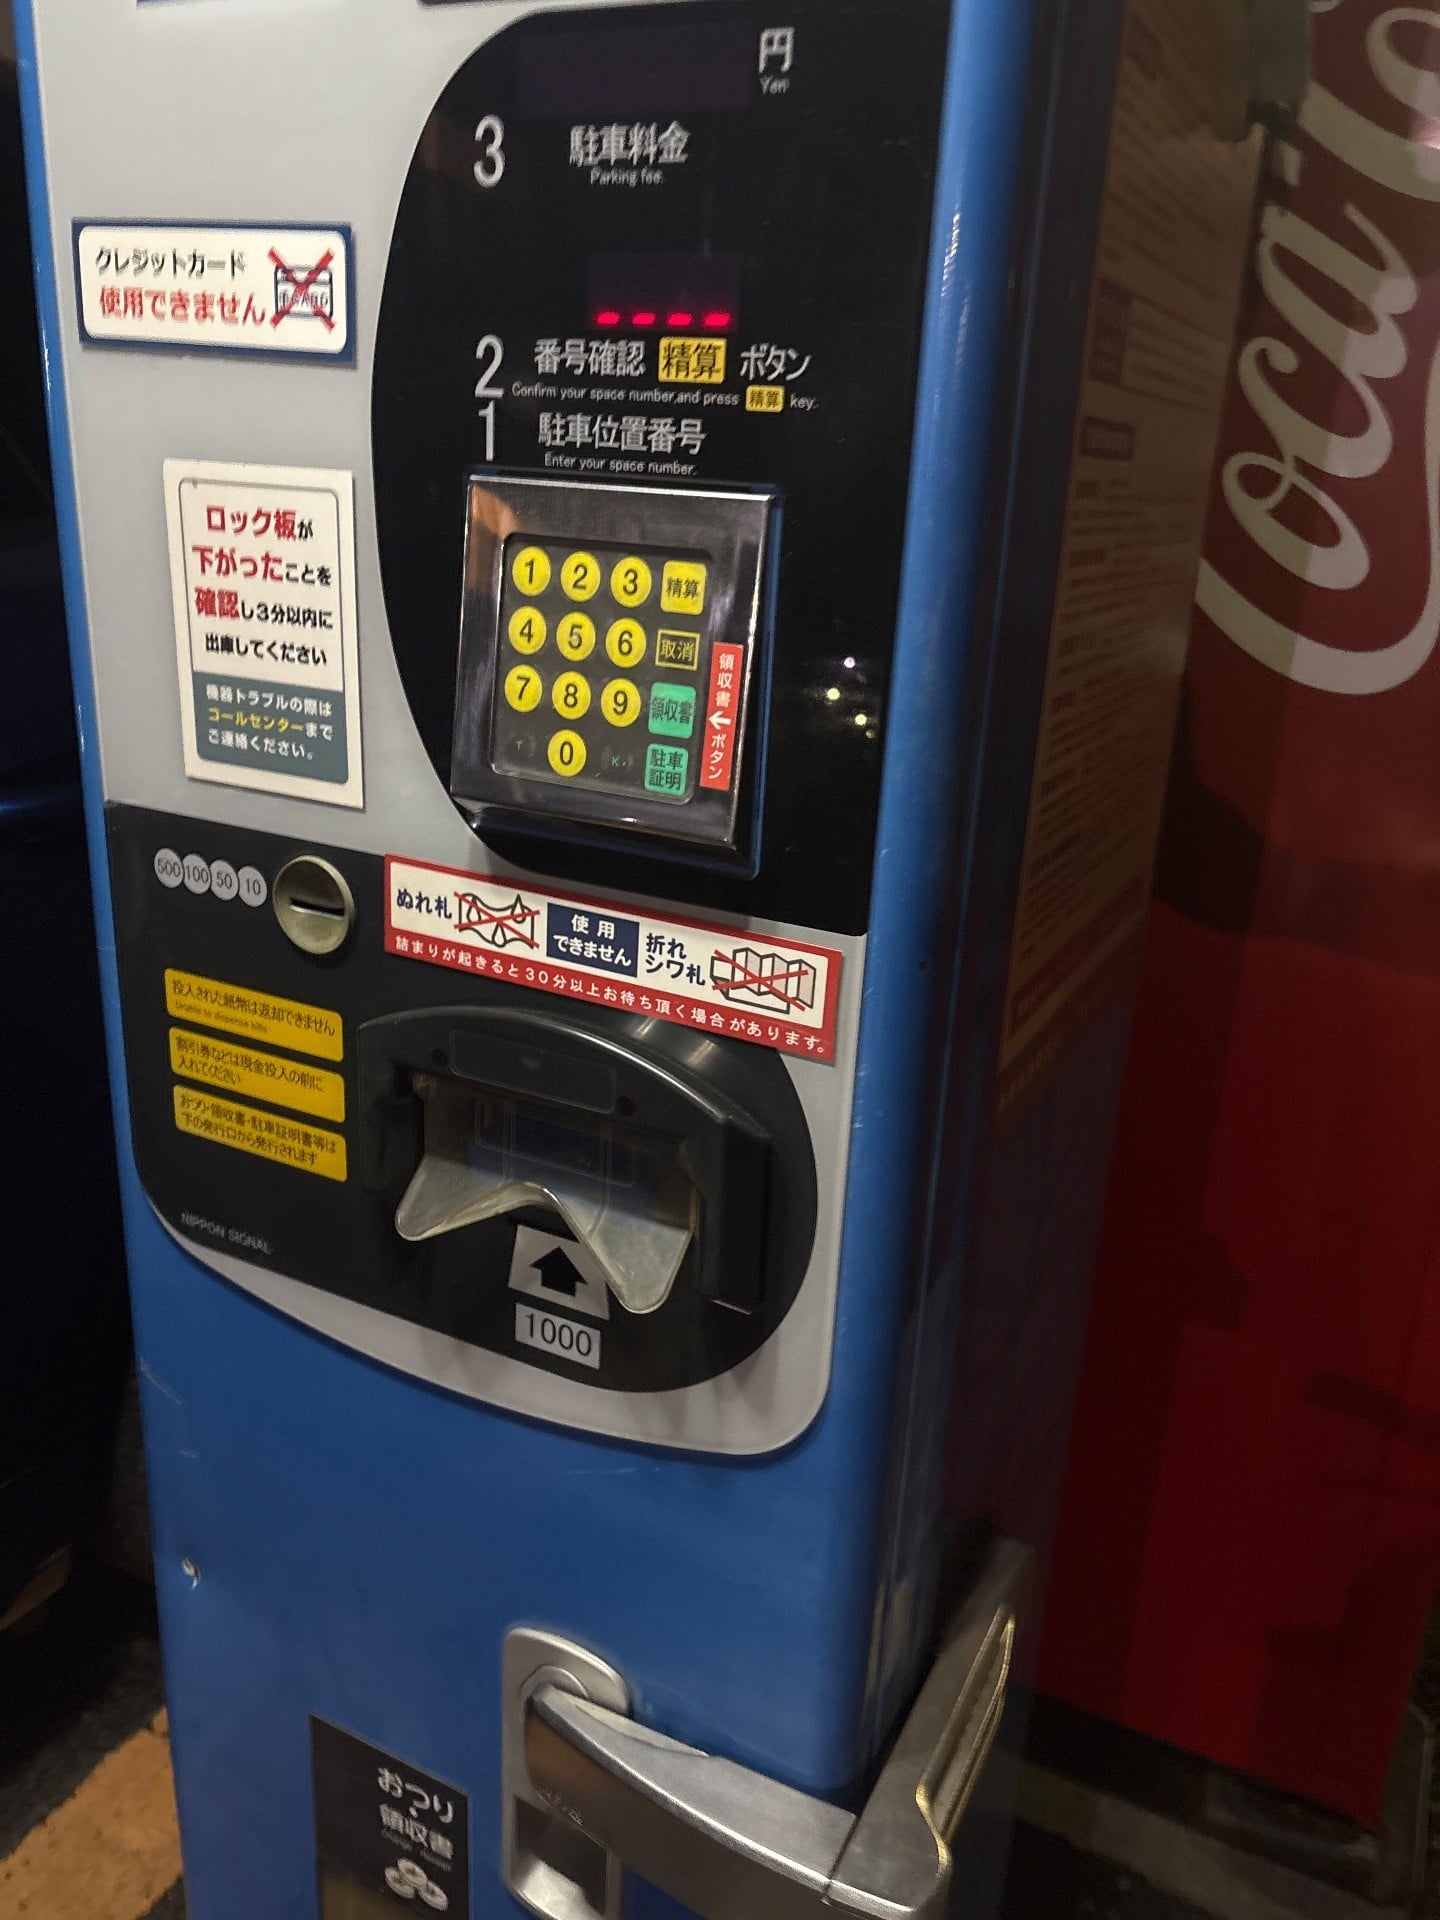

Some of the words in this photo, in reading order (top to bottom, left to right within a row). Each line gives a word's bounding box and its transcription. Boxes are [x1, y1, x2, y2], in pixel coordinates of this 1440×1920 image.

[759, 26, 795, 73] 円
[760, 77, 790, 94] Yen
[473, 114, 505, 188] 3
[569, 120, 691, 167] 駐車料金
[590, 166, 637, 188] Parking
[96, 248, 246, 280] クレジットカード
[100, 286, 266, 327] 使用できません
[474, 334, 503, 399] 2
[534, 338, 646, 378] 番号確認
[662, 344, 722, 380] 精算
[740, 343, 811, 381] ボタン
[512, 382, 556, 399] Confirm
[560, 386, 588, 400] your
[590, 388, 625, 402] space
[703, 392, 738, 407] press
[749, 390, 780, 408] 精算
[478, 400, 496, 461] 1
[538, 411, 706, 455] 駐車位置番号
[544, 453, 575, 468] Enter
[579, 455, 605, 470] your
[609, 459, 645, 473] space
[648, 460, 697, 476] number.
[206, 504, 313, 540] ロック板が
[192, 545, 332, 587] 下がったことを
[524, 558, 536, 584] 1
[572, 564, 588, 590] 2
[622, 569, 638, 595] 3
[665, 577, 701, 600] 精算
[195, 587, 333, 629] 確認し3分以内に
[205, 633, 327, 666] 出庫してください
[519, 619, 534, 644] 4
[568, 624, 584, 649] 5
[617, 630, 633, 656] 6
[660, 638, 694, 661] 取消
[516, 676, 531, 701] 7
[563, 682, 579, 709] 8
[612, 690, 629, 715] 9
[714, 652, 735, 709] 領収書
[206, 684, 332, 718] 機器トラブルの際は
[651, 695, 693, 725] 領収書
[208, 707, 333, 741] コールセンターまで
[208, 728, 314, 760] ご連絡ください。
[560, 741, 573, 766] 0
[651, 749, 684, 770] 駐車
[707, 733, 727, 780] ボタン
[649, 769, 682, 791] 証明
[157, 858, 181, 878] 500
[185, 864, 209, 884] 100
[216, 872, 233, 889] 50
[246, 878, 261, 896] 10
[397, 888, 452, 919] ぬれ札
[571, 914, 614, 940] 使用
[553, 934, 632, 968] できません
[646, 932, 686, 959] 折れ
[645, 953, 706, 986] シワ札
[525, 1312, 592, 1357] 1000
